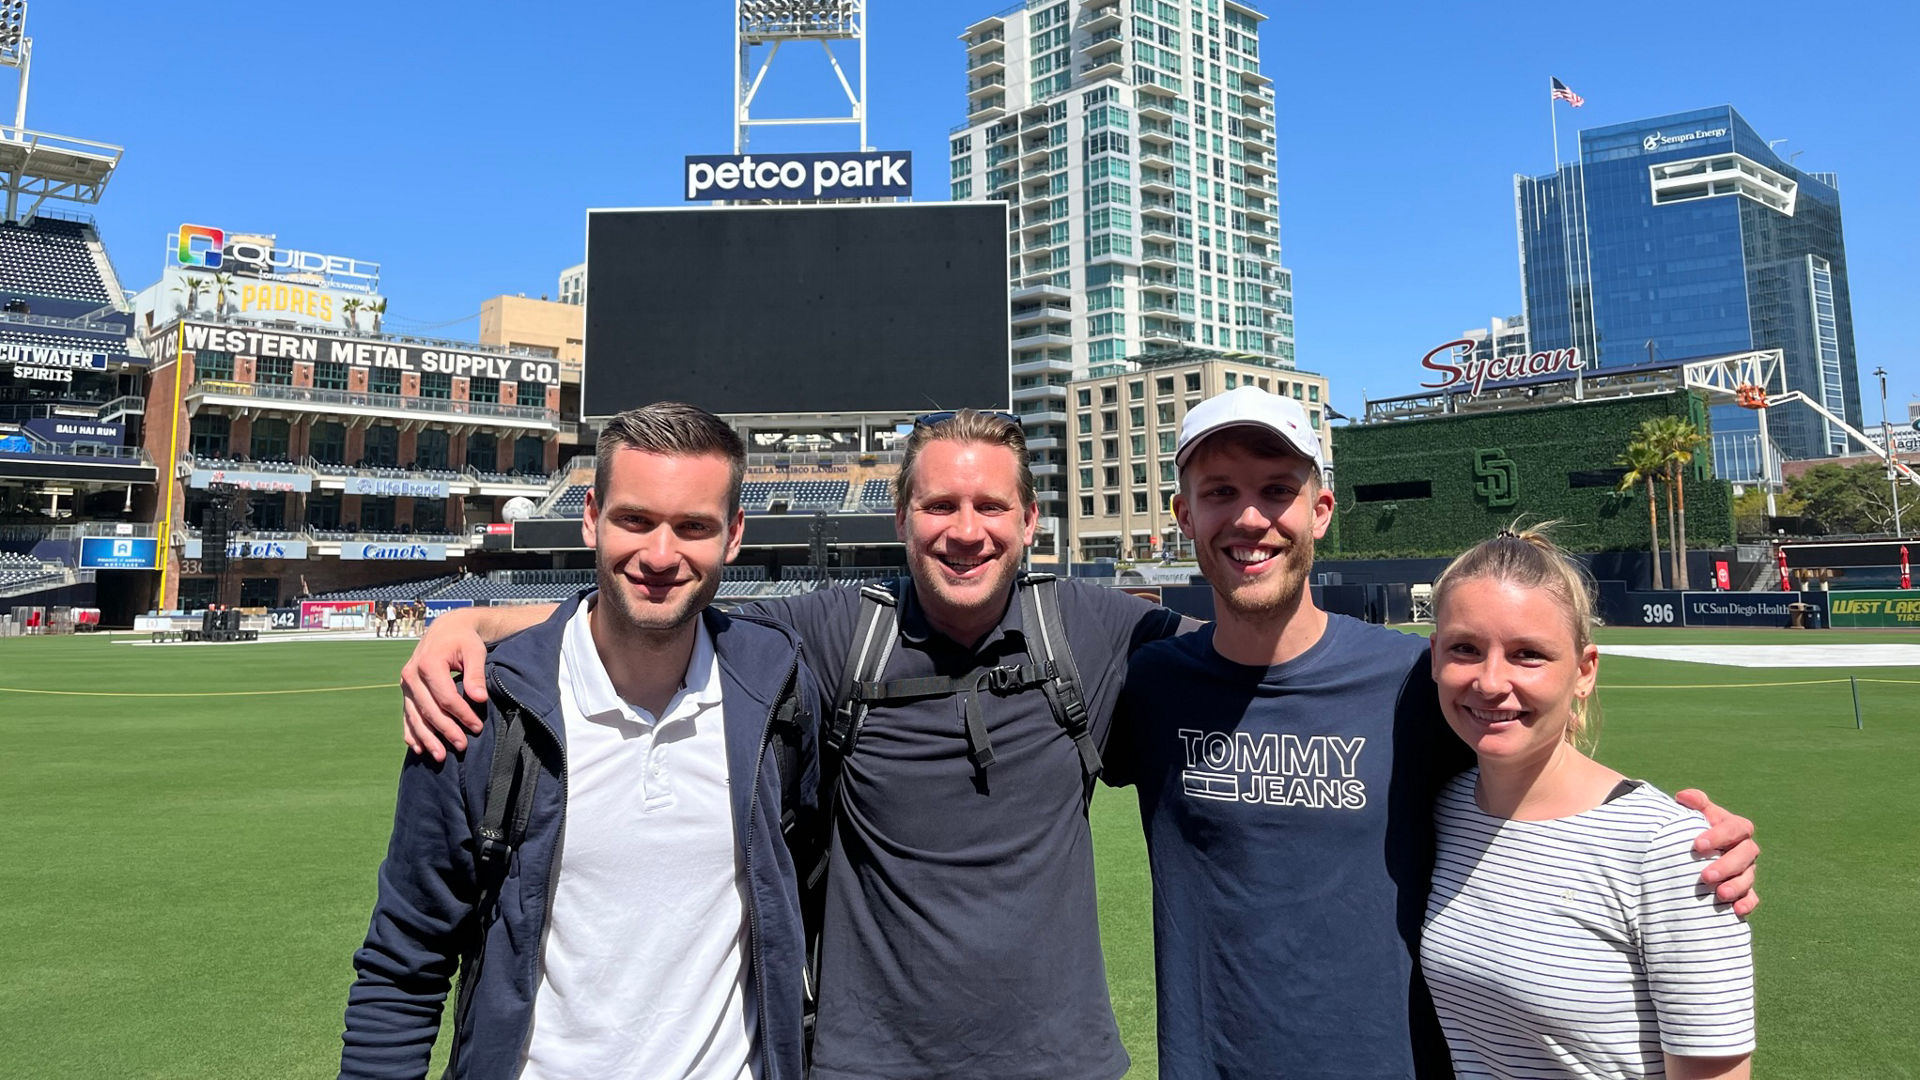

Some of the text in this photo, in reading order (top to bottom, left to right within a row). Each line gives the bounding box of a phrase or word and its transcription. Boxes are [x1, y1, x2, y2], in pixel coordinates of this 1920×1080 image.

[1661, 127, 1727, 143] Sempra Energy
[688, 155, 907, 198] petco park
[232, 243, 379, 279] QUIDEL
[241, 284, 333, 322] PADRES
[0, 345, 93, 368] CUTWATER
[184, 325, 558, 384] WESTERN METAL SUPPLY CO.
[13, 366, 73, 382] SPIRITS
[1420, 339, 1586, 397] Sycuan
[56, 424, 117, 437] BALI HAI RUM
[1475, 449, 1519, 507] SD
[362, 544, 428, 560] Canel's
[1643, 603, 1674, 623] 396
[1693, 603, 1790, 616] UC San Diego Health
[1832, 599, 1881, 614] WEST
[271, 612, 295, 627] 342
[1178, 728, 1366, 777] TOMMY
[1241, 775, 1367, 809] JEANS
